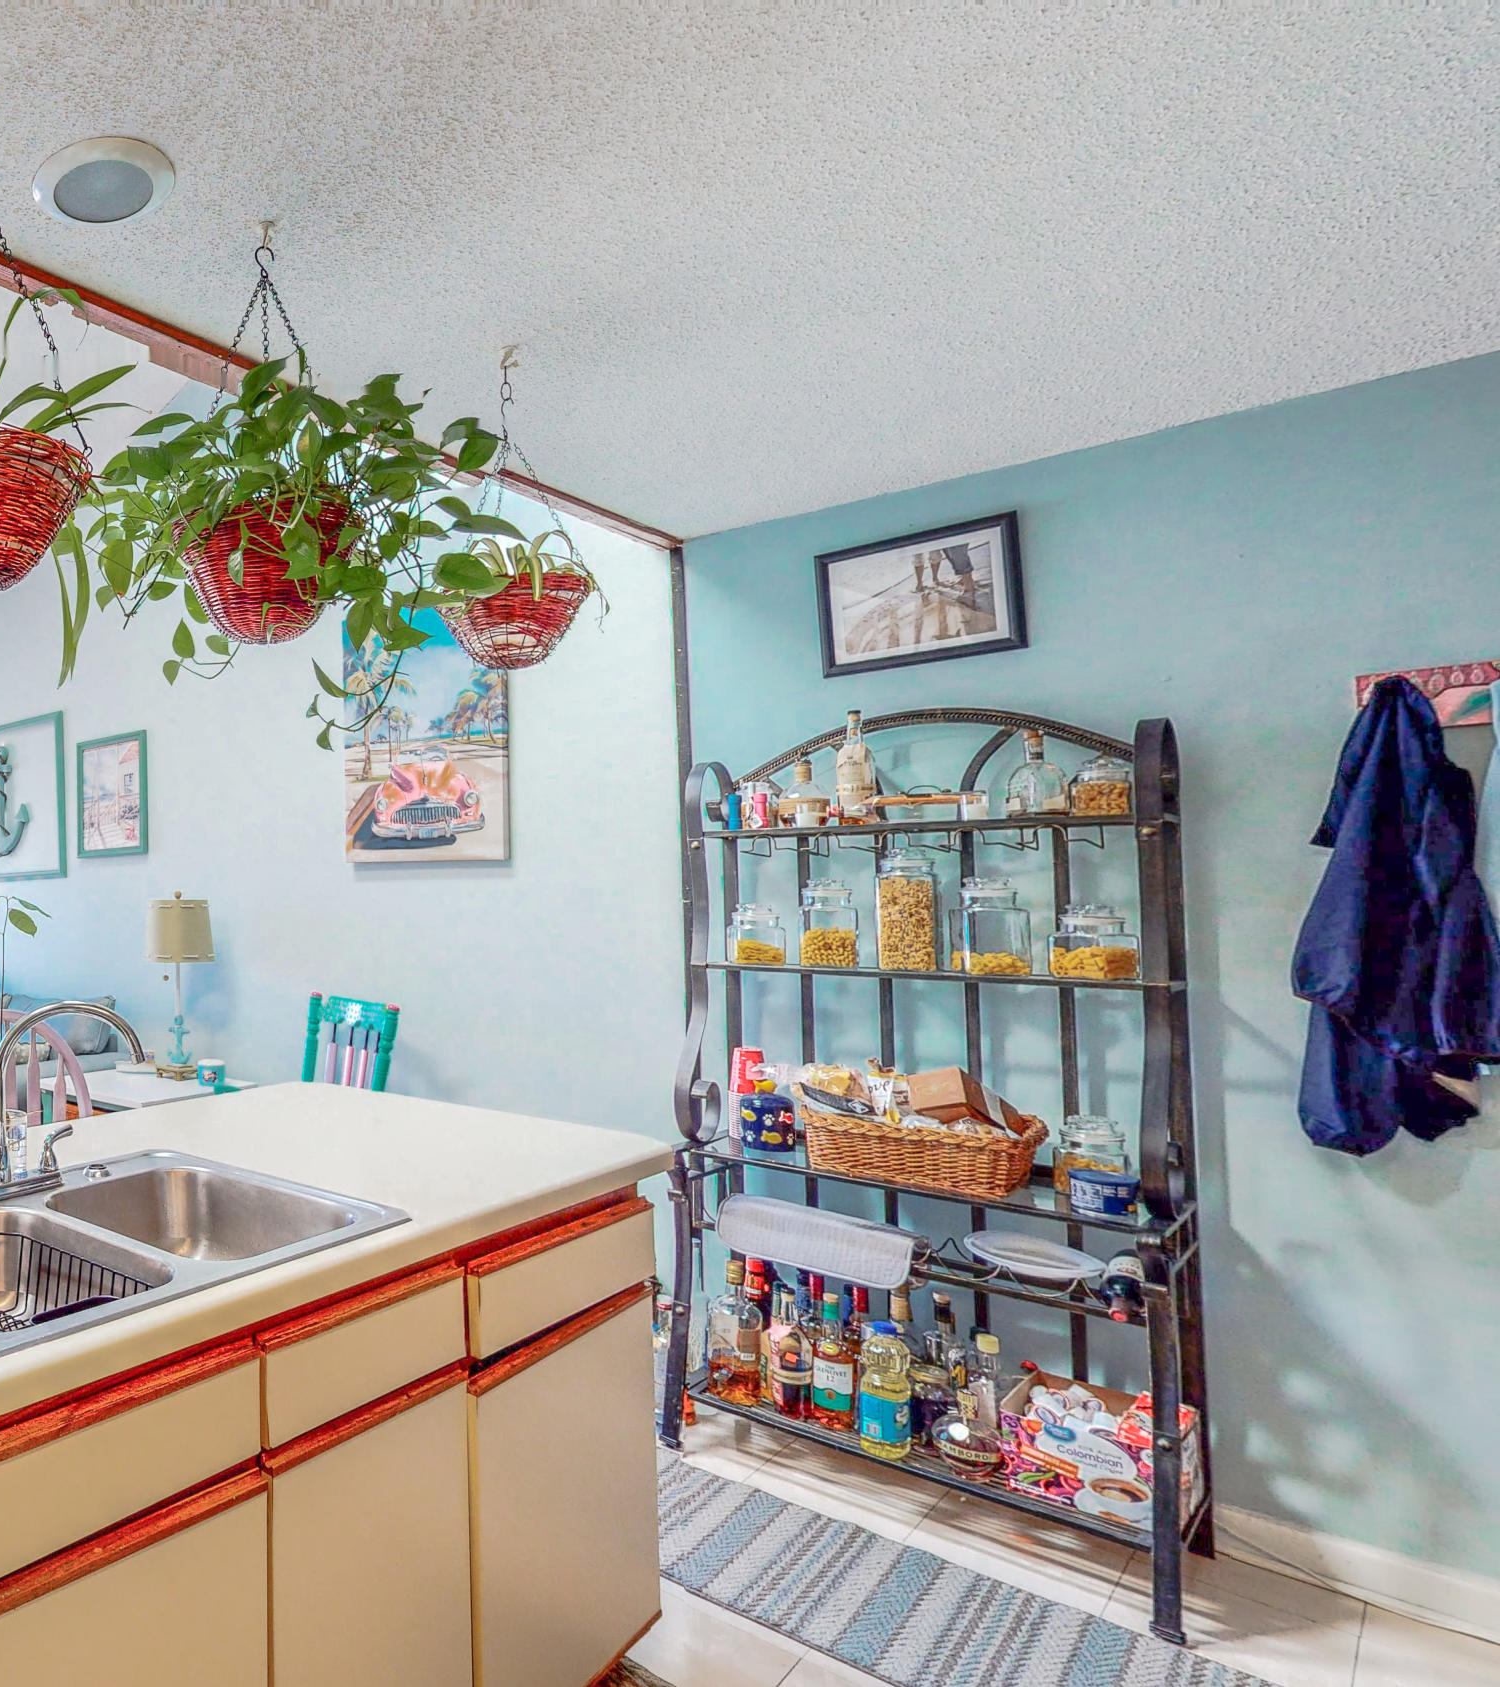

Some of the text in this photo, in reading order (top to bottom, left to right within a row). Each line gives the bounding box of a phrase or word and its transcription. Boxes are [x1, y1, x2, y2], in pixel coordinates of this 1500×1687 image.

[826, 1375, 835, 1383] 12
[939, 1441, 989, 1461] AMBORD
[1056, 1444, 1124, 1469] Colombian
